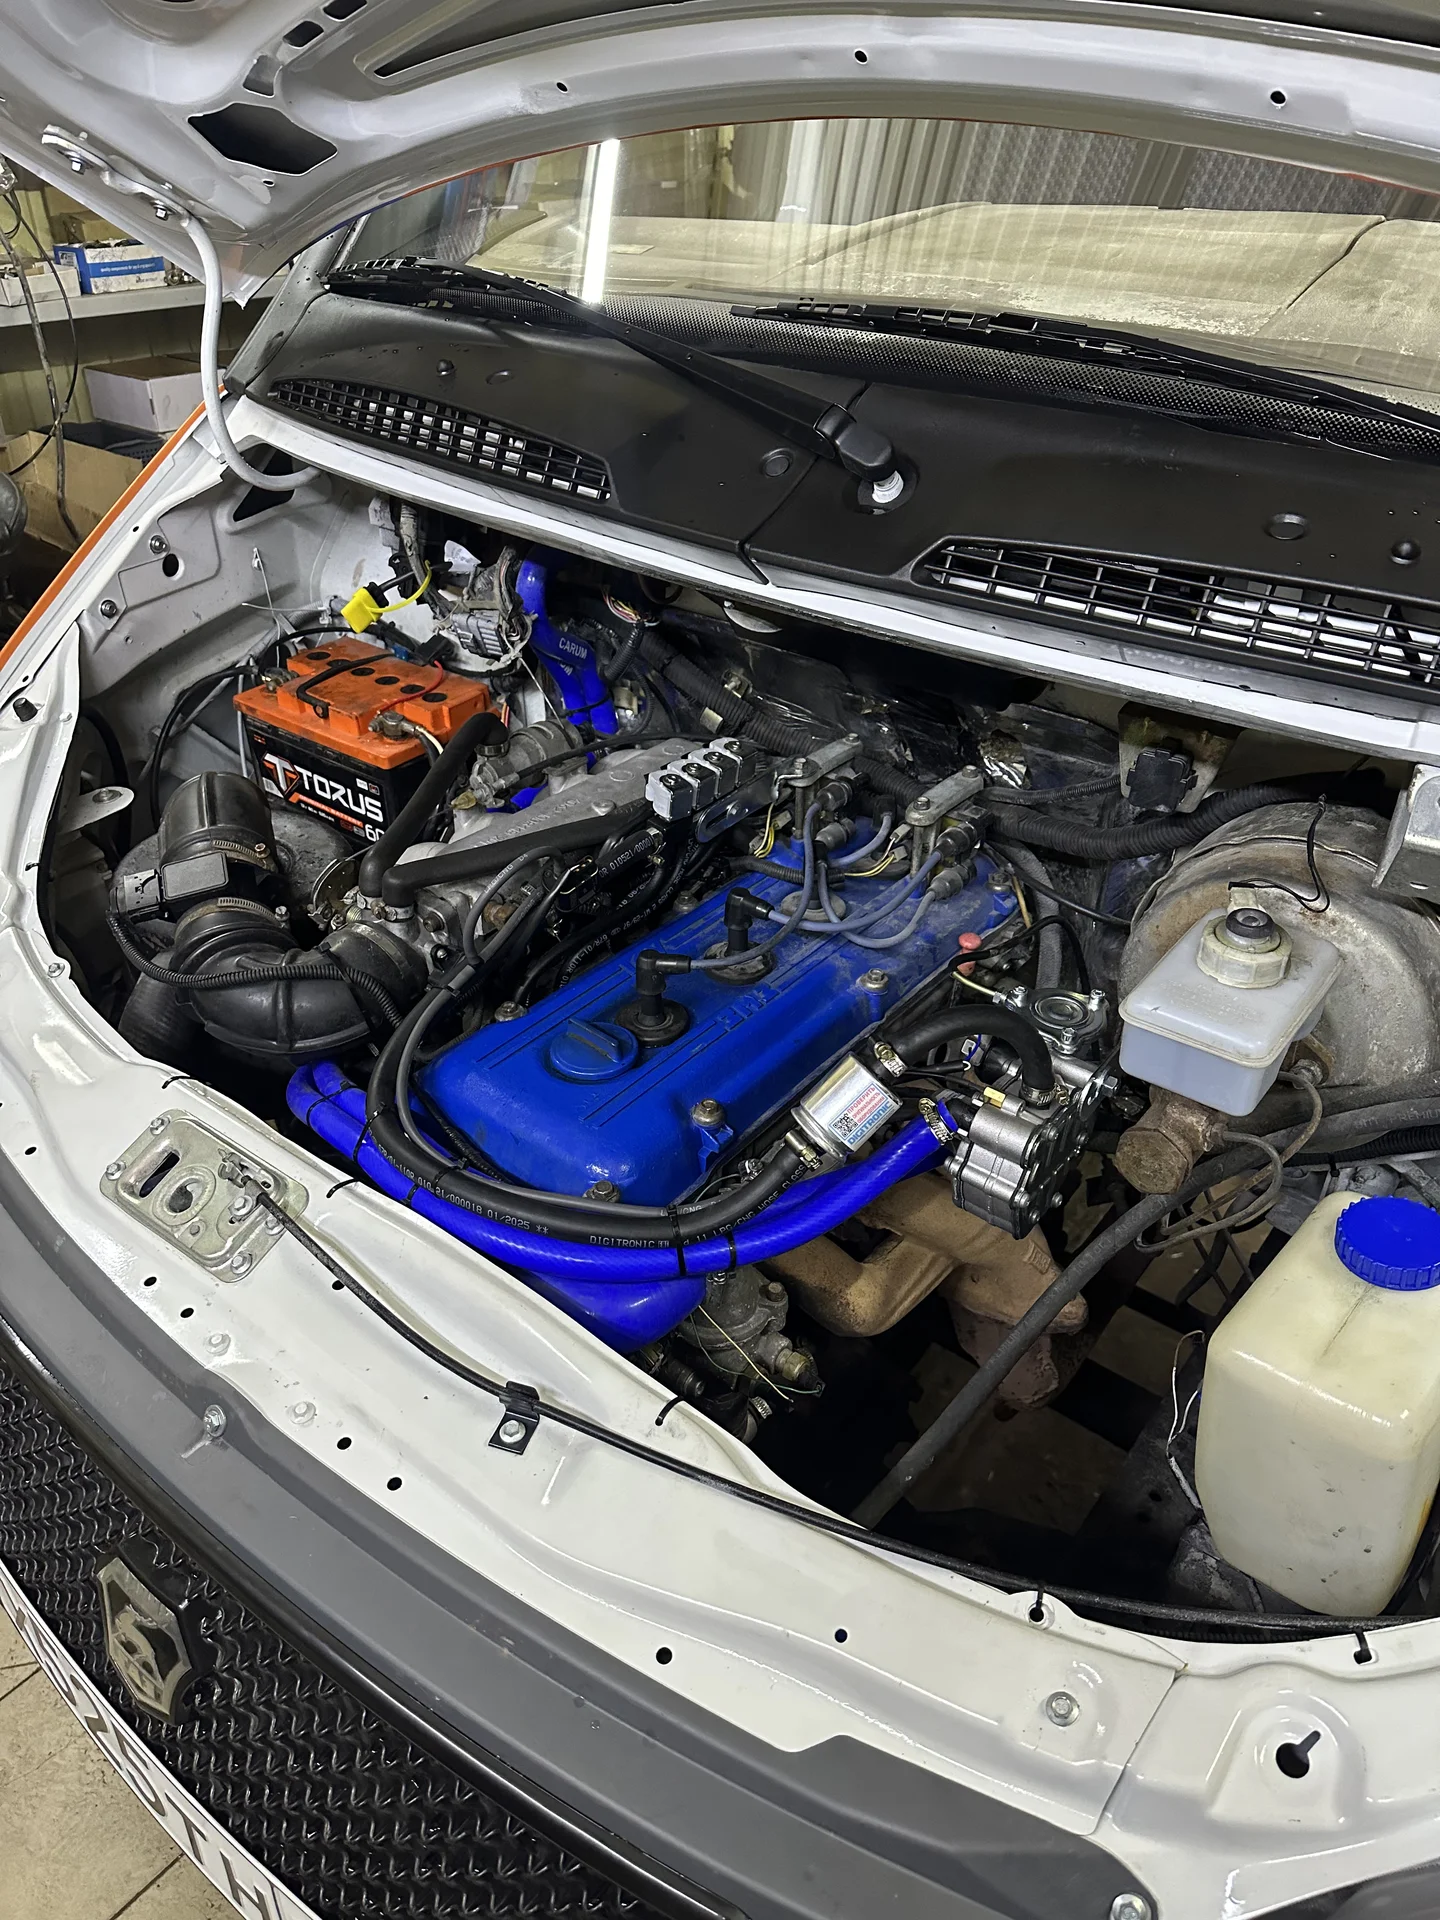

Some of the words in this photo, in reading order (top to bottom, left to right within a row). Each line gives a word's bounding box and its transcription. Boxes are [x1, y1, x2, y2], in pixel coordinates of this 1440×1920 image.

[558, 637, 588, 660] CARUM
[293, 764, 384, 823] TORUS
[609, 834, 656, 871] 010521/00001
[846, 1086, 876, 1114] ПРОВЕРИТЬ
[847, 1101, 891, 1145] DIGITRONIC
[417, 1176, 483, 1215] 01021/000018
[487, 1208, 531, 1231] 01/2025
[589, 1235, 657, 1249] DIGITRONIC
[782, 1164, 807, 1190] CLASS
